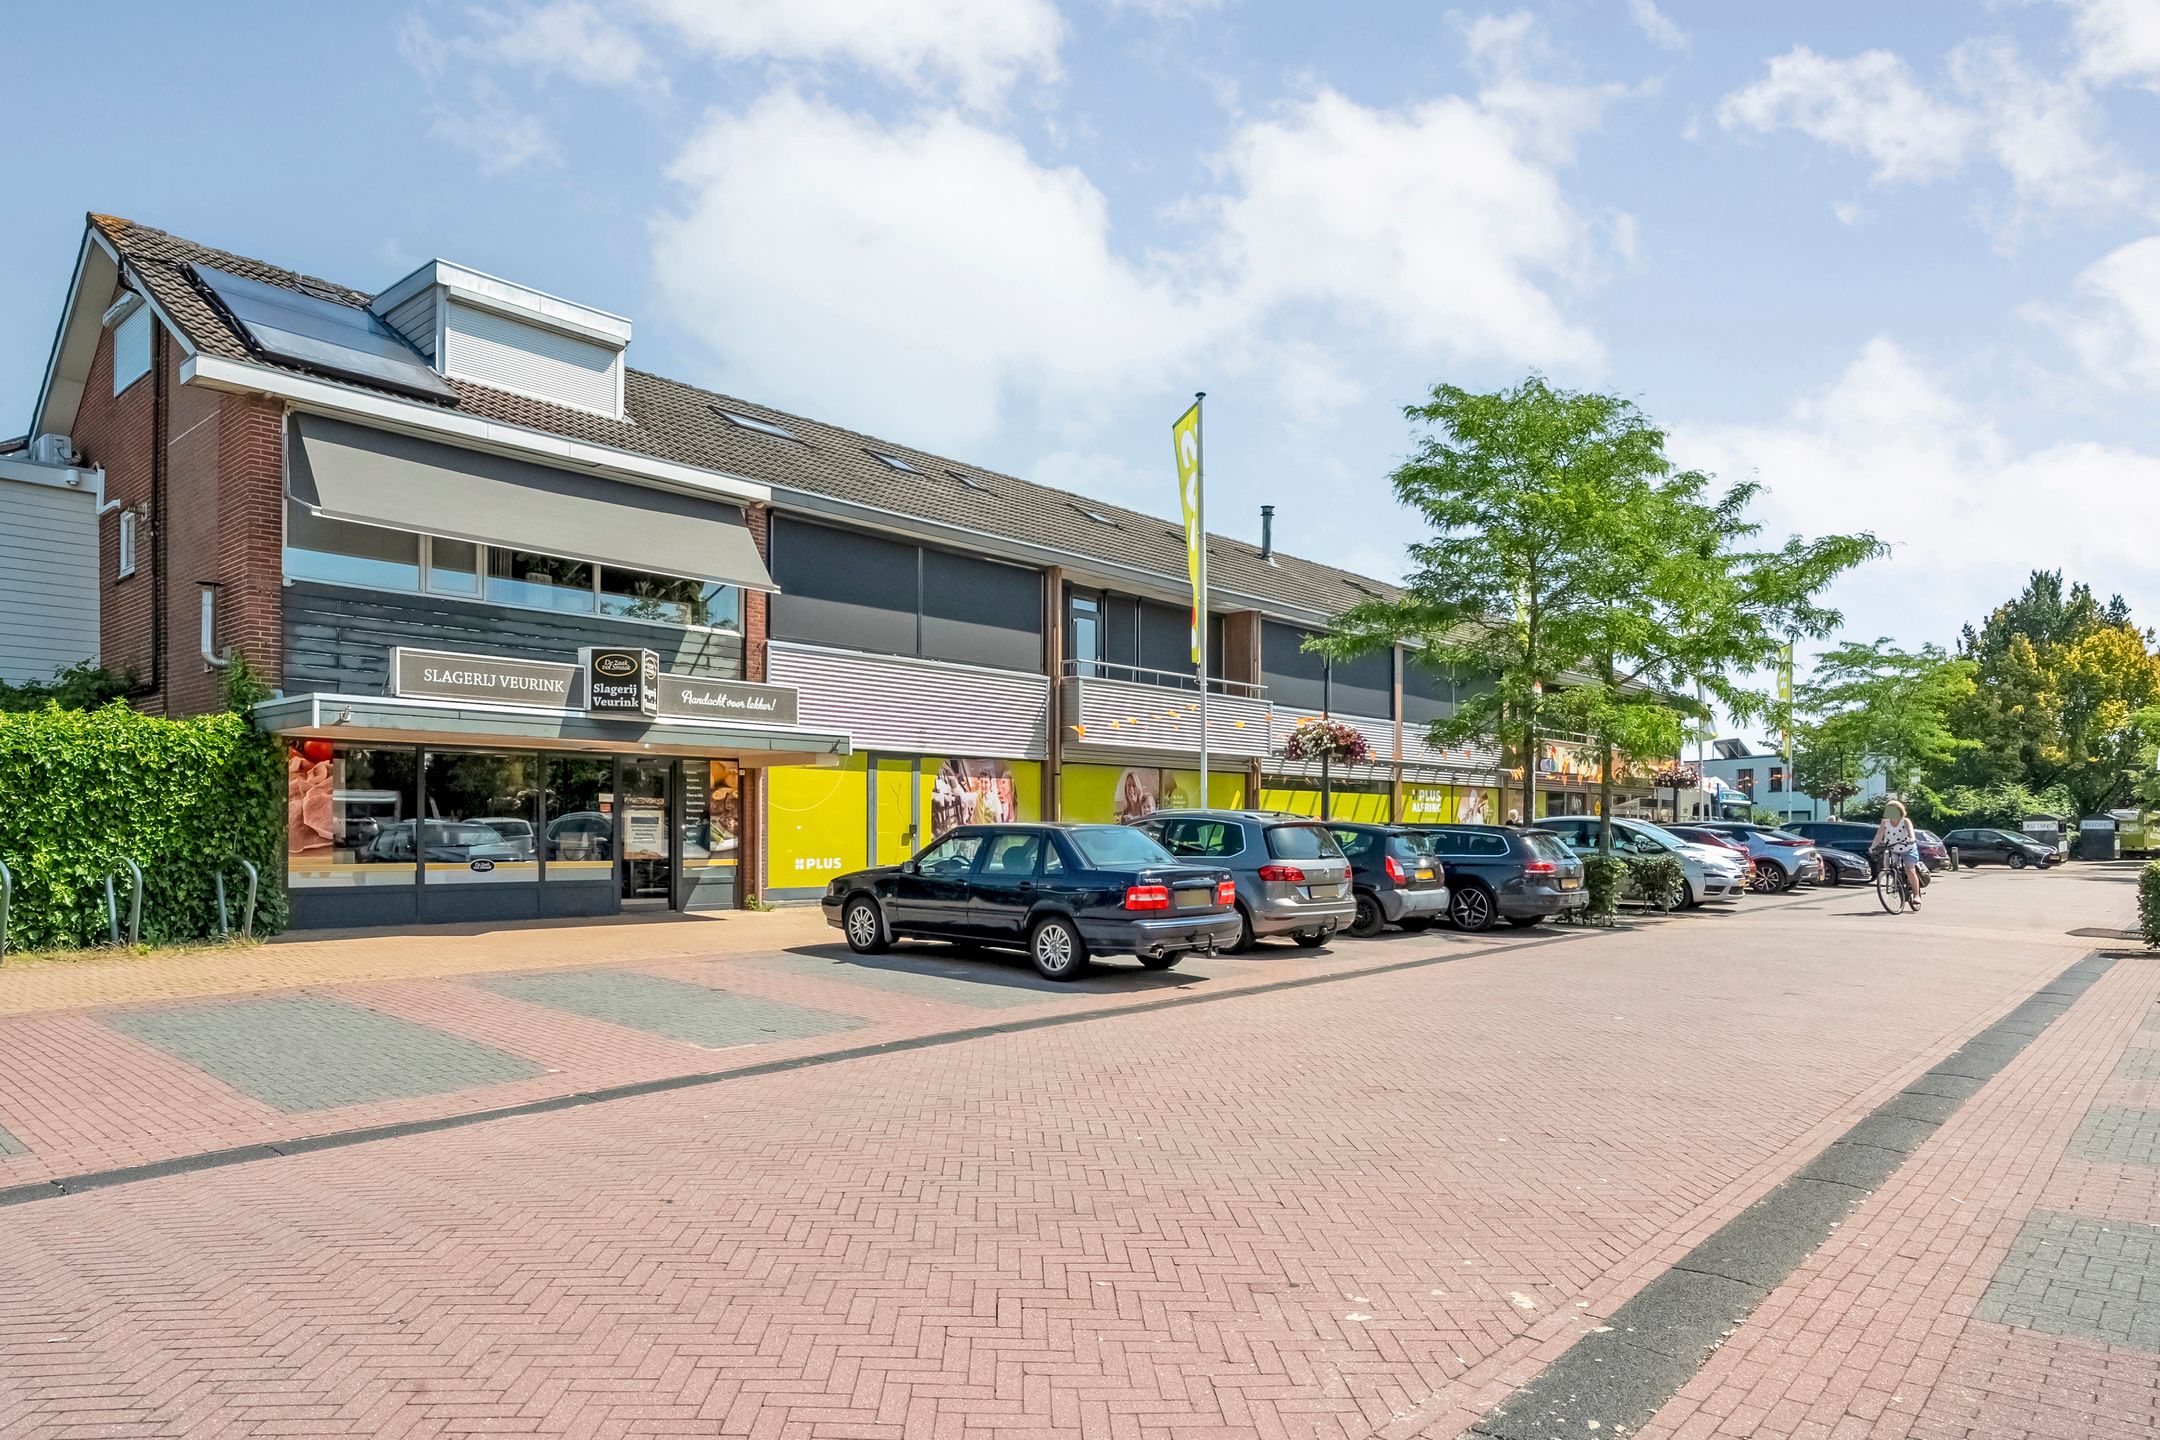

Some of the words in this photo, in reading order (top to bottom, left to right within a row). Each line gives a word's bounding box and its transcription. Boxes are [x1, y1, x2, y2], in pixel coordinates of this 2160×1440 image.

[423, 668, 497, 688] SLAGERIJ
[499, 675, 565, 693] VEURINK
[593, 683, 637, 696] Slagerij
[593, 696, 639, 708] Veurink
[681, 690, 726, 708] Aandacht
[726, 698, 746, 709] voor
[746, 695, 777, 711] lekker!
[1419, 789, 1441, 802] PLUS
[806, 857, 842, 869] PLUS
